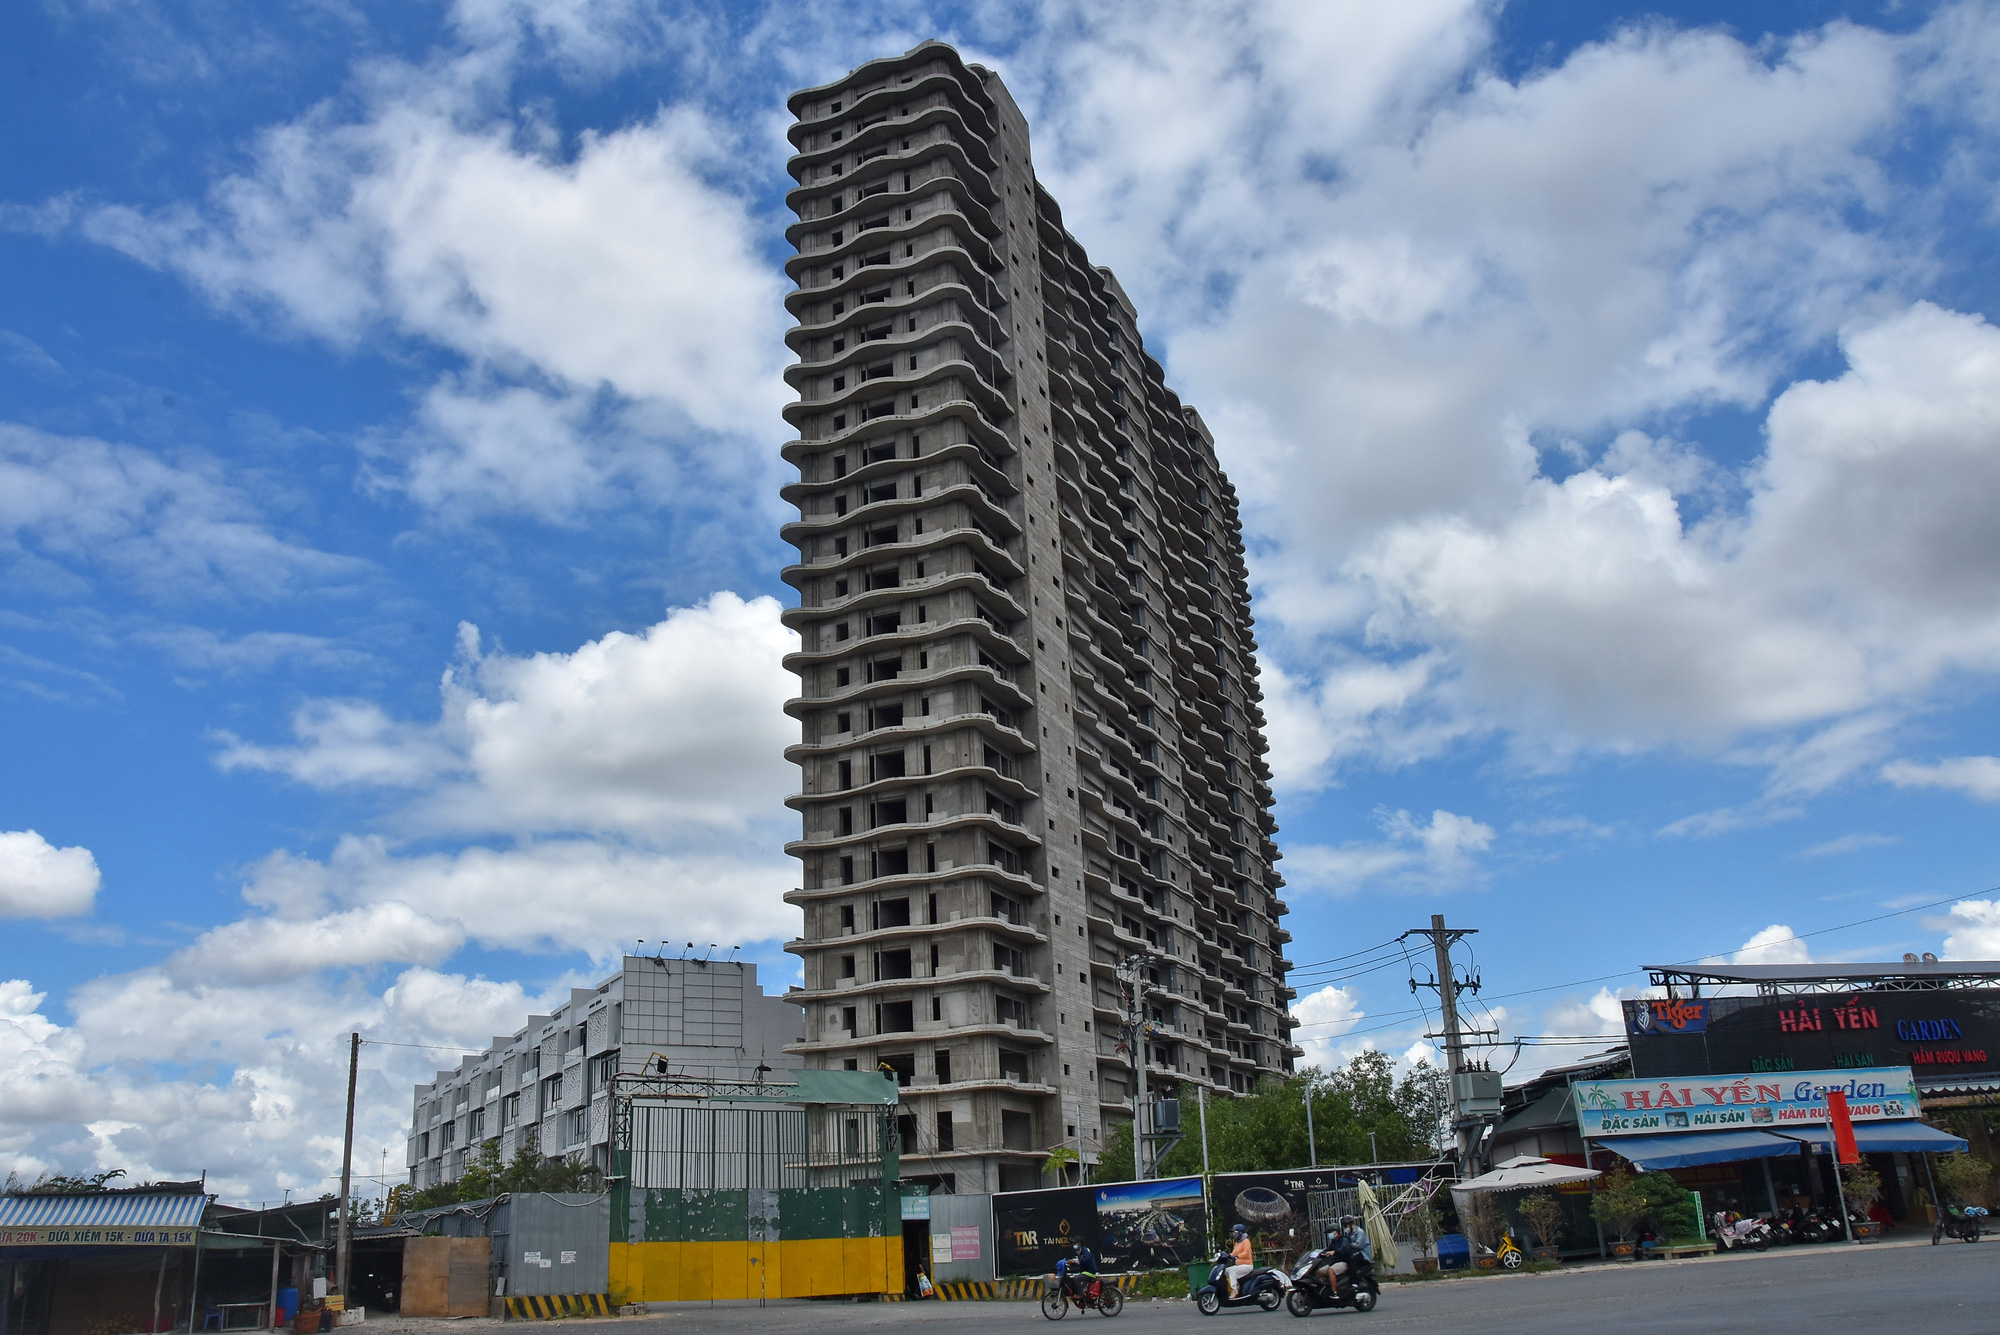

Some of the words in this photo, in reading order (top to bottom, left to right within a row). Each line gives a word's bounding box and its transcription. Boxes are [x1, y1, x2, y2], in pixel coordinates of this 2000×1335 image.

[1651, 999, 1703, 1029] Tiger
[1779, 1000, 1822, 1032] HẢI
[1832, 995, 1878, 1029] YẾN
[1897, 1019, 1963, 1041] GARDEN
[1961, 1049, 1987, 1063] VANG
[1621, 1082, 1696, 1111] HẢI
[1701, 1077, 1782, 1106] YẾN
[1694, 1109, 1717, 1125] HẢI
[1719, 1109, 1745, 1123] SẢN
[1778, 1104, 1807, 1120] HẦM
[1848, 1104, 1880, 1116] VANG
[1632, 1114, 1660, 1129] SẢN
[1290, 1180, 1305, 1188] TNR
[16, 1231, 37, 1243] 20K
[73, 1229, 101, 1242] XIÊM
[104, 1231, 124, 1242] 15K
[173, 1231, 192, 1242] 15K
[1014, 1230, 1039, 1246] TNR
